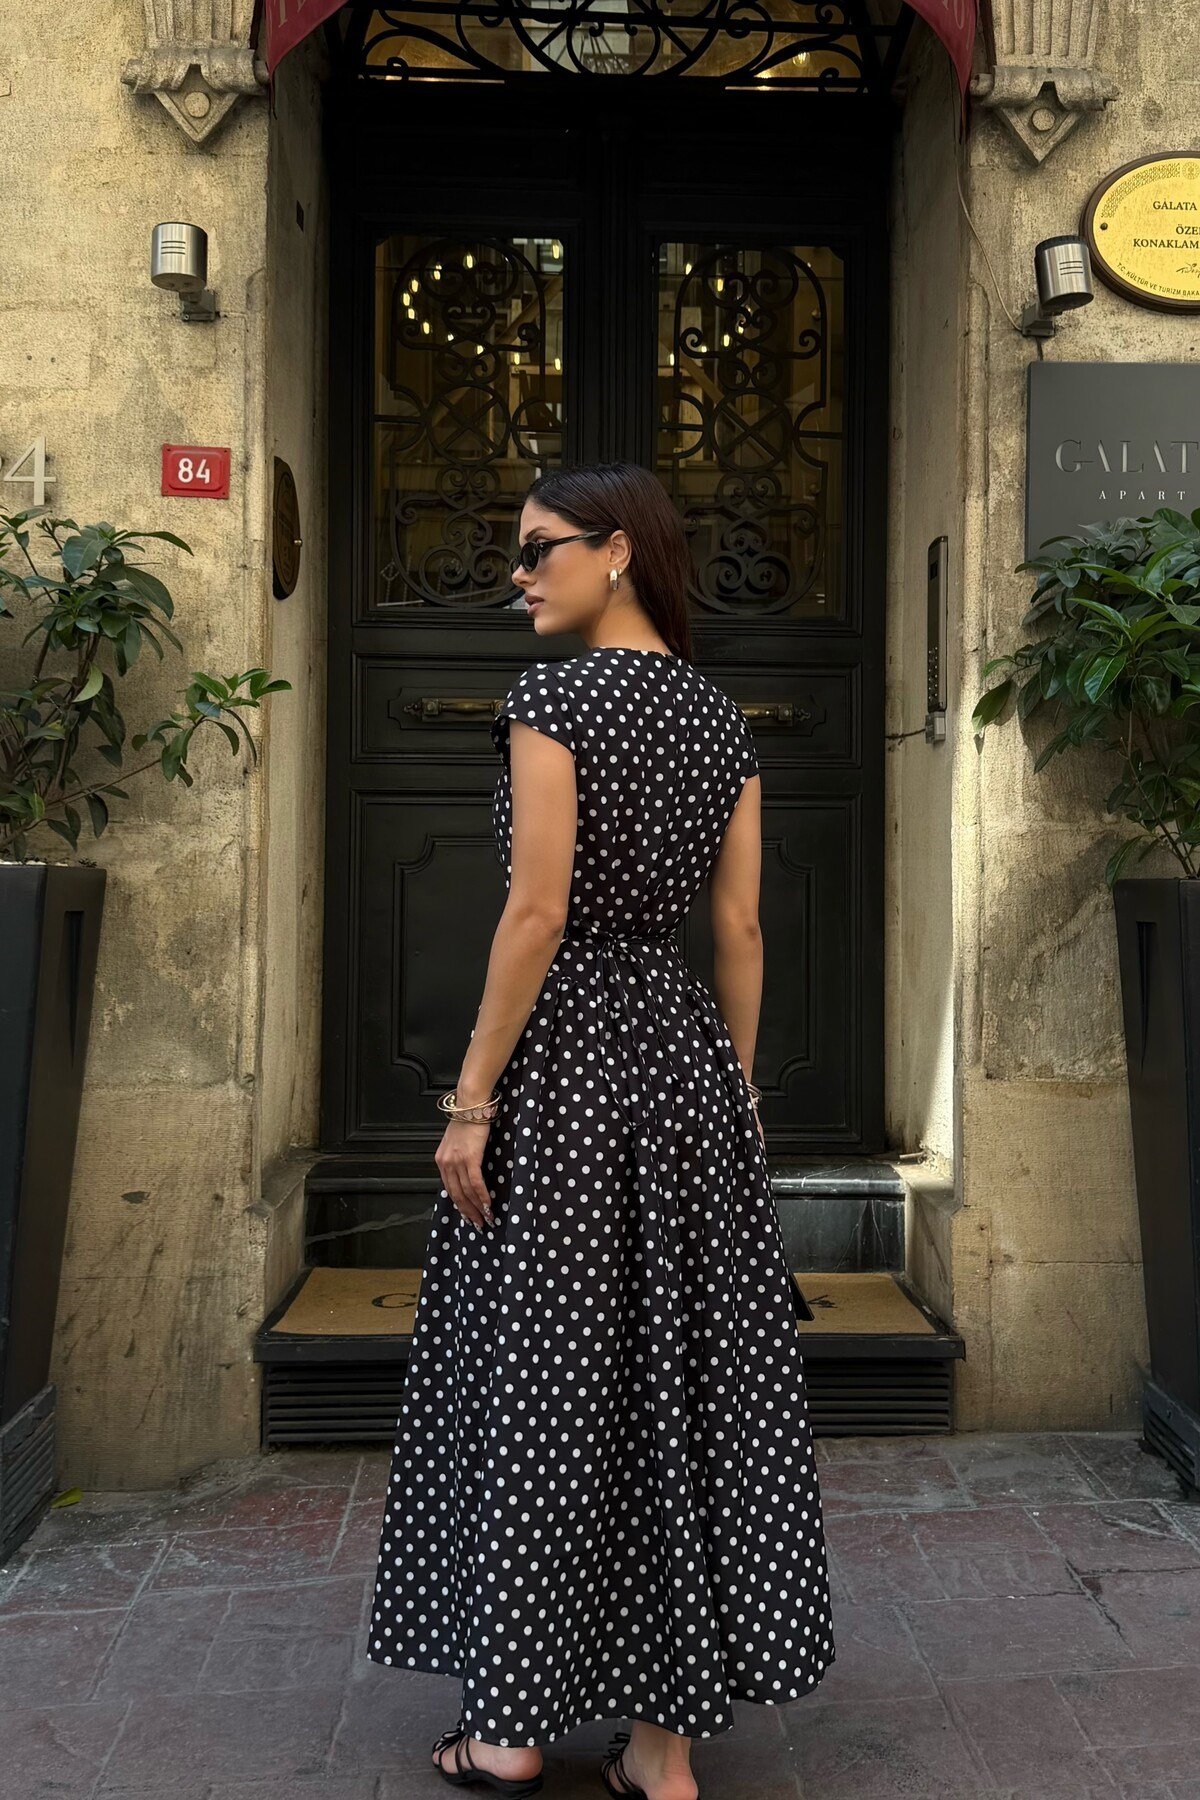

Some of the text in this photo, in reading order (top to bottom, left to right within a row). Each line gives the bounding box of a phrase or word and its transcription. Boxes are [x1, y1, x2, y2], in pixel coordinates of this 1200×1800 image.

[1175, 223, 1200, 236] ÖZE
[1133, 238, 1199, 249] KONAKLAM
[1126, 271, 1149, 287] KÜLTÜR
[1149, 282, 1158, 291] VE
[1055, 439, 1199, 473] GALAT
[177, 457, 211, 484] 84
[1099, 490, 1186, 500] APART
